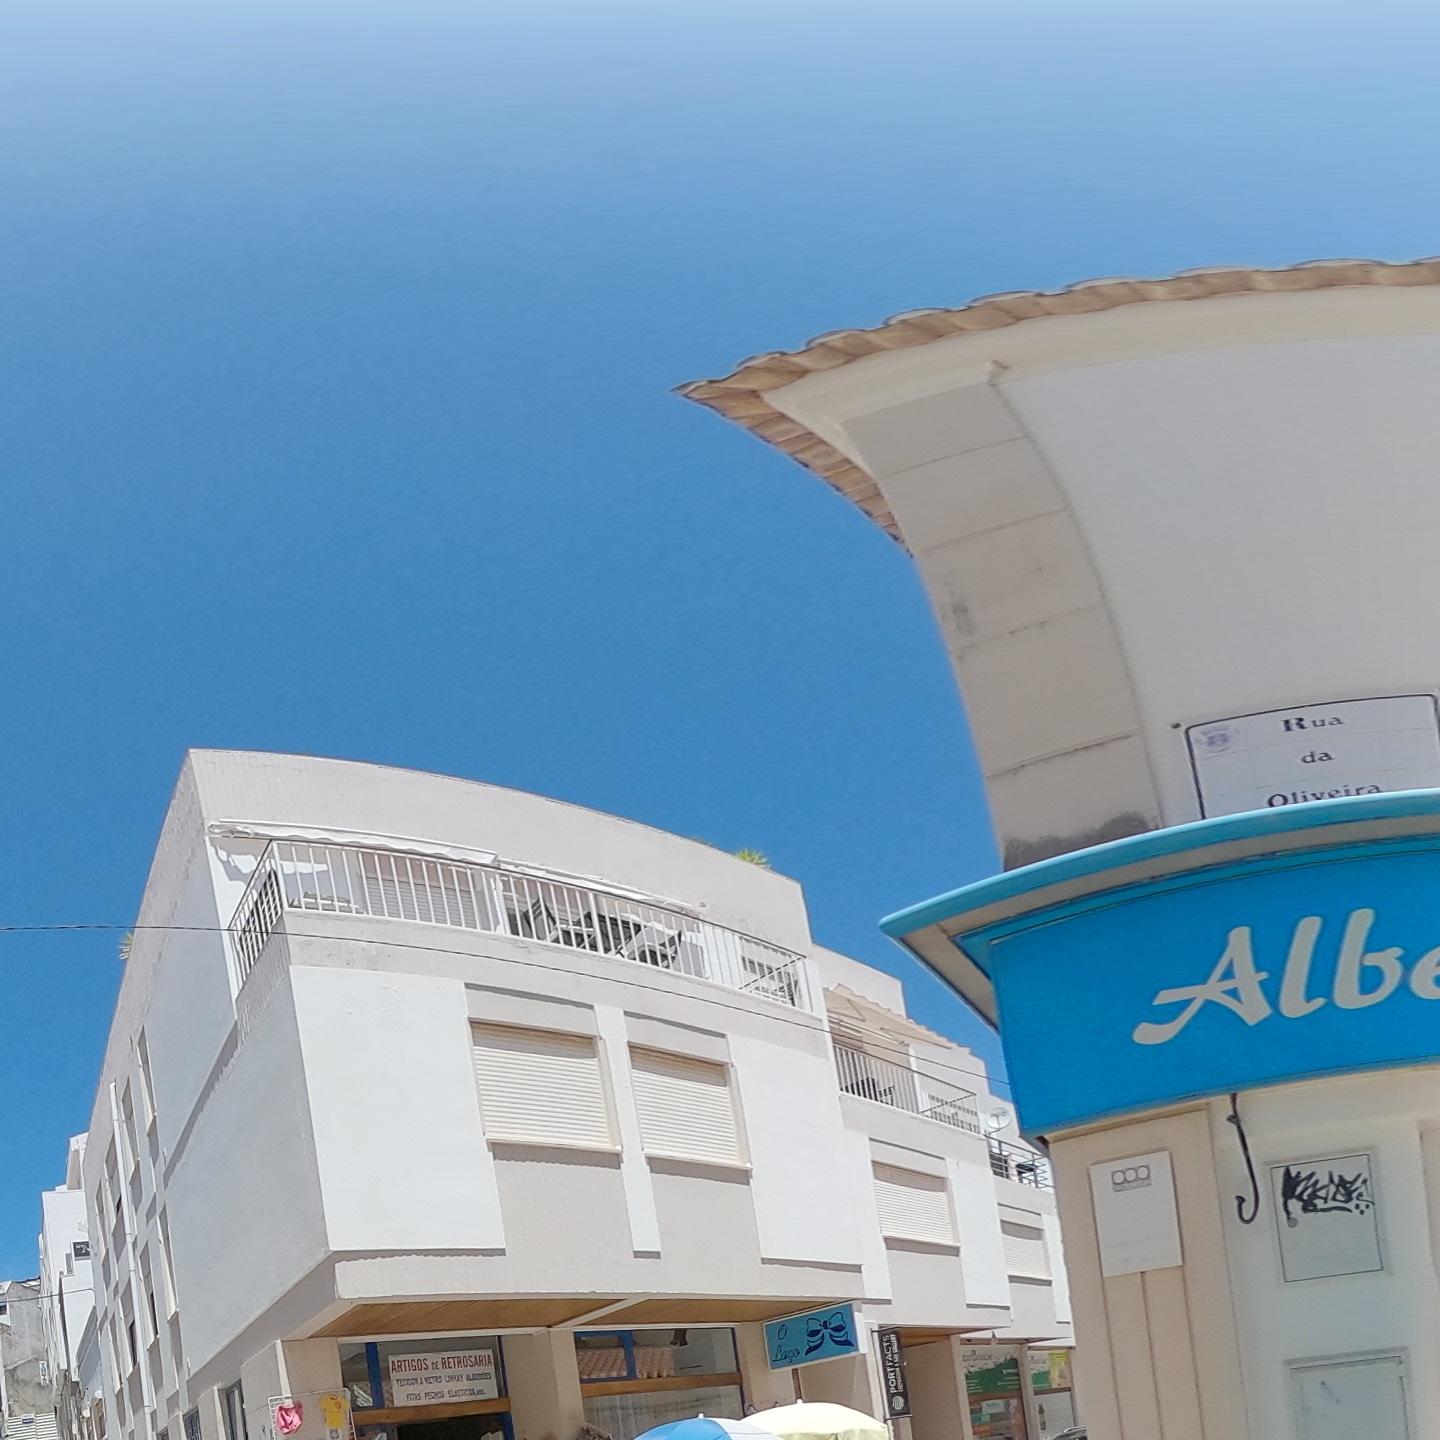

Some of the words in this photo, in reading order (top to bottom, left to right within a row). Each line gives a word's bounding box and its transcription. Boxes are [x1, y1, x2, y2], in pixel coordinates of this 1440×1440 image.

[1280, 717, 1343, 732] Rua
[1301, 751, 1335, 764] da
[1267, 783, 1382, 808] Oliveira
[777, 1324, 788, 1341] O
[391, 1358, 428, 1374] ARTIGOS
[441, 1355, 493, 1370] RETROSARIA
